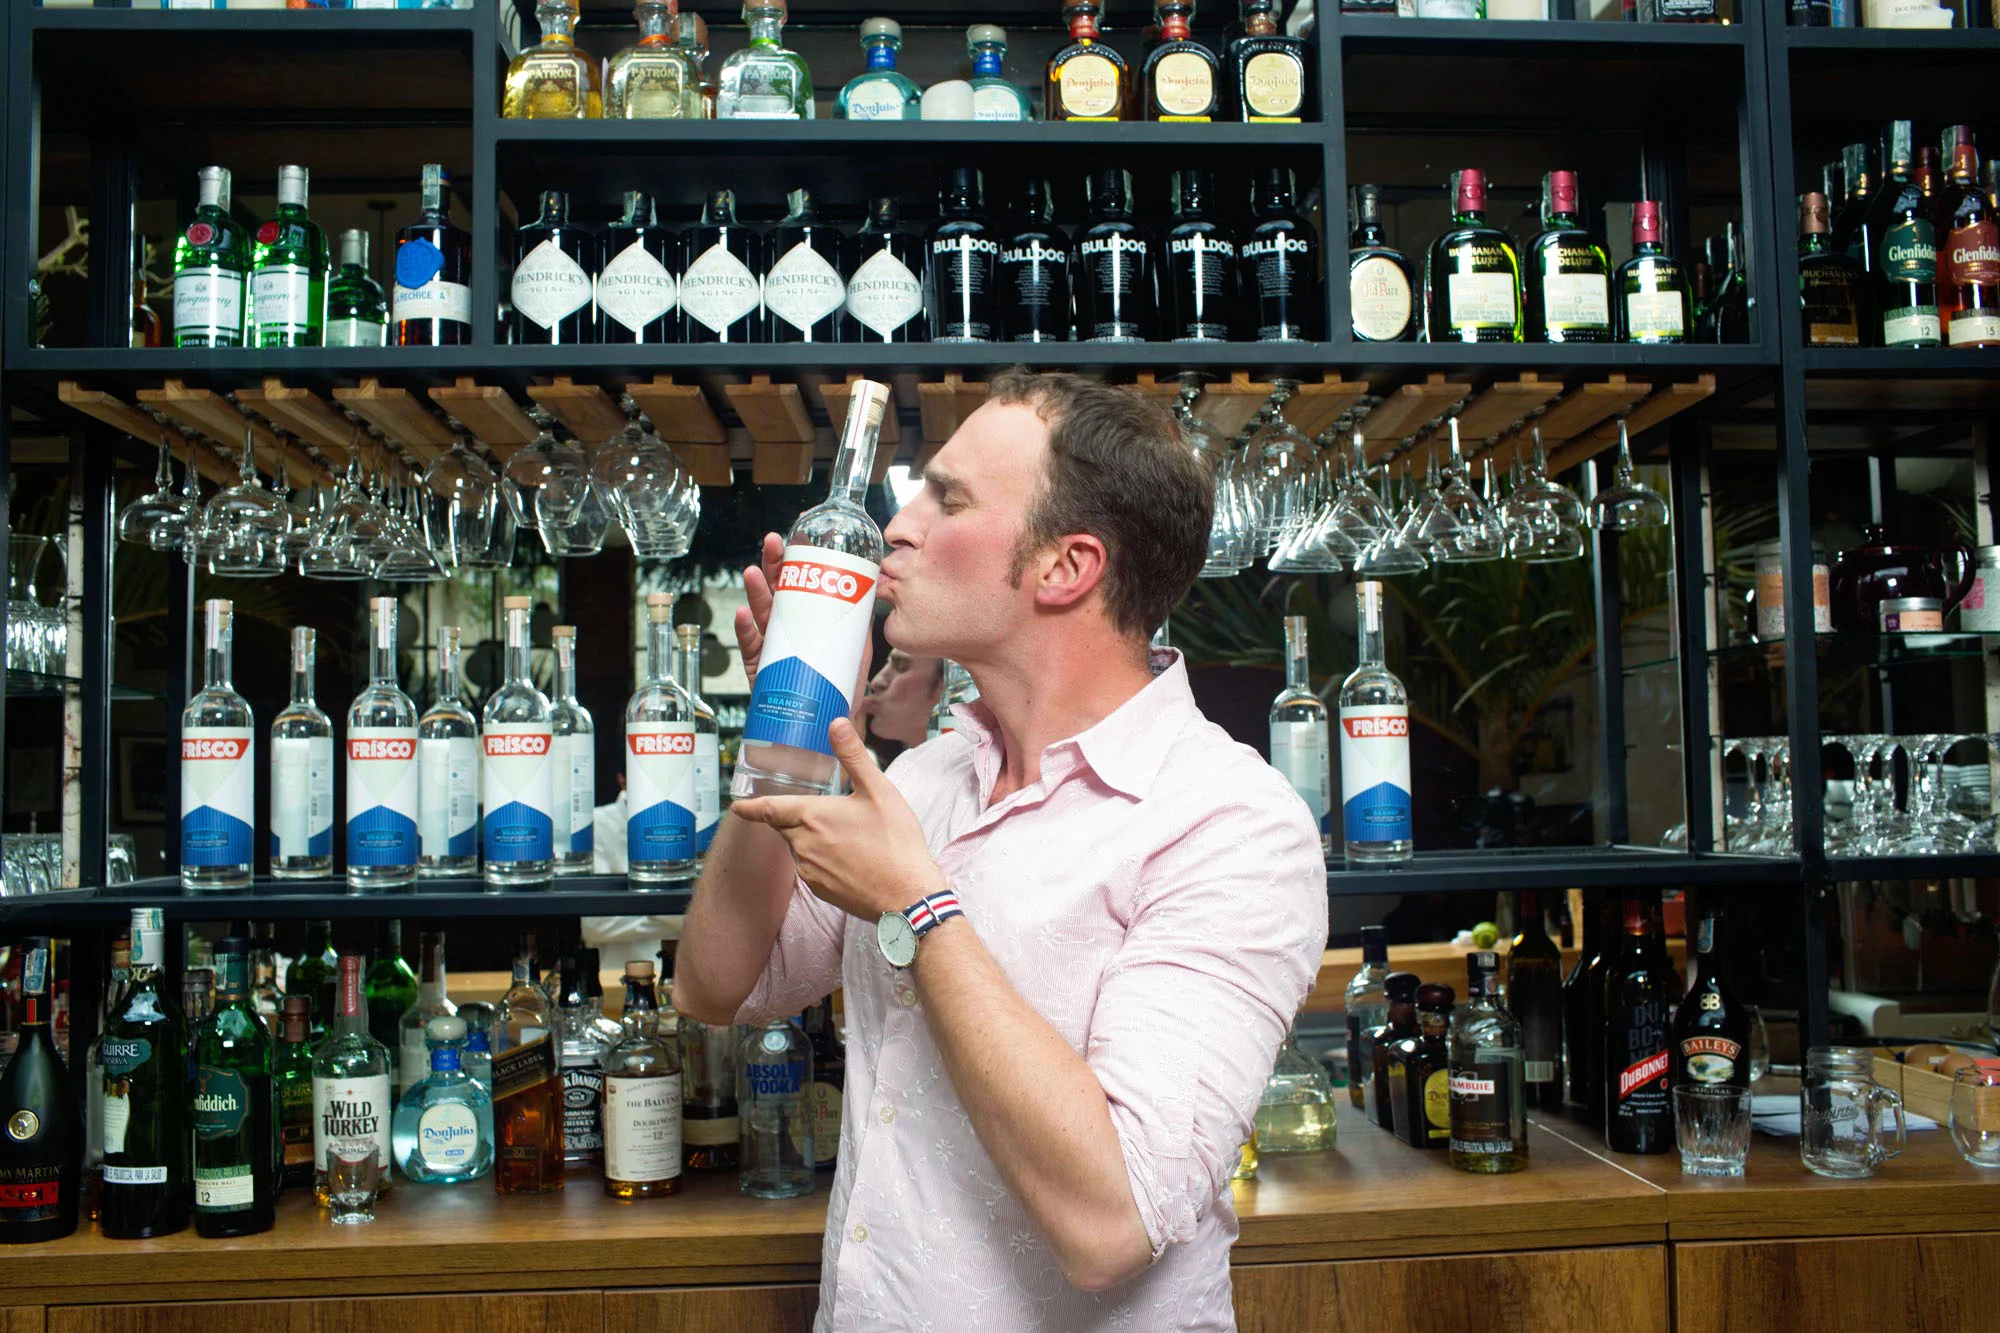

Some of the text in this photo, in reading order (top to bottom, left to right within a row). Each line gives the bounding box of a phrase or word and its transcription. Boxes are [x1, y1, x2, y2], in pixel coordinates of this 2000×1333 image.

[933, 239, 998, 254] BULDOG
[1172, 239, 1234, 255] BULDOG
[1242, 239, 1308, 258] BULLOG
[767, 696, 805, 709] BRANDY
[1683, 1039, 1736, 1054] BAILEYS
[1620, 1052, 1669, 1094] DUBONNET
[751, 1079, 800, 1095] VODKA
[330, 1100, 372, 1118] WILD
[322, 1115, 380, 1138] TURKEY
[200, 1191, 211, 1203] 12
